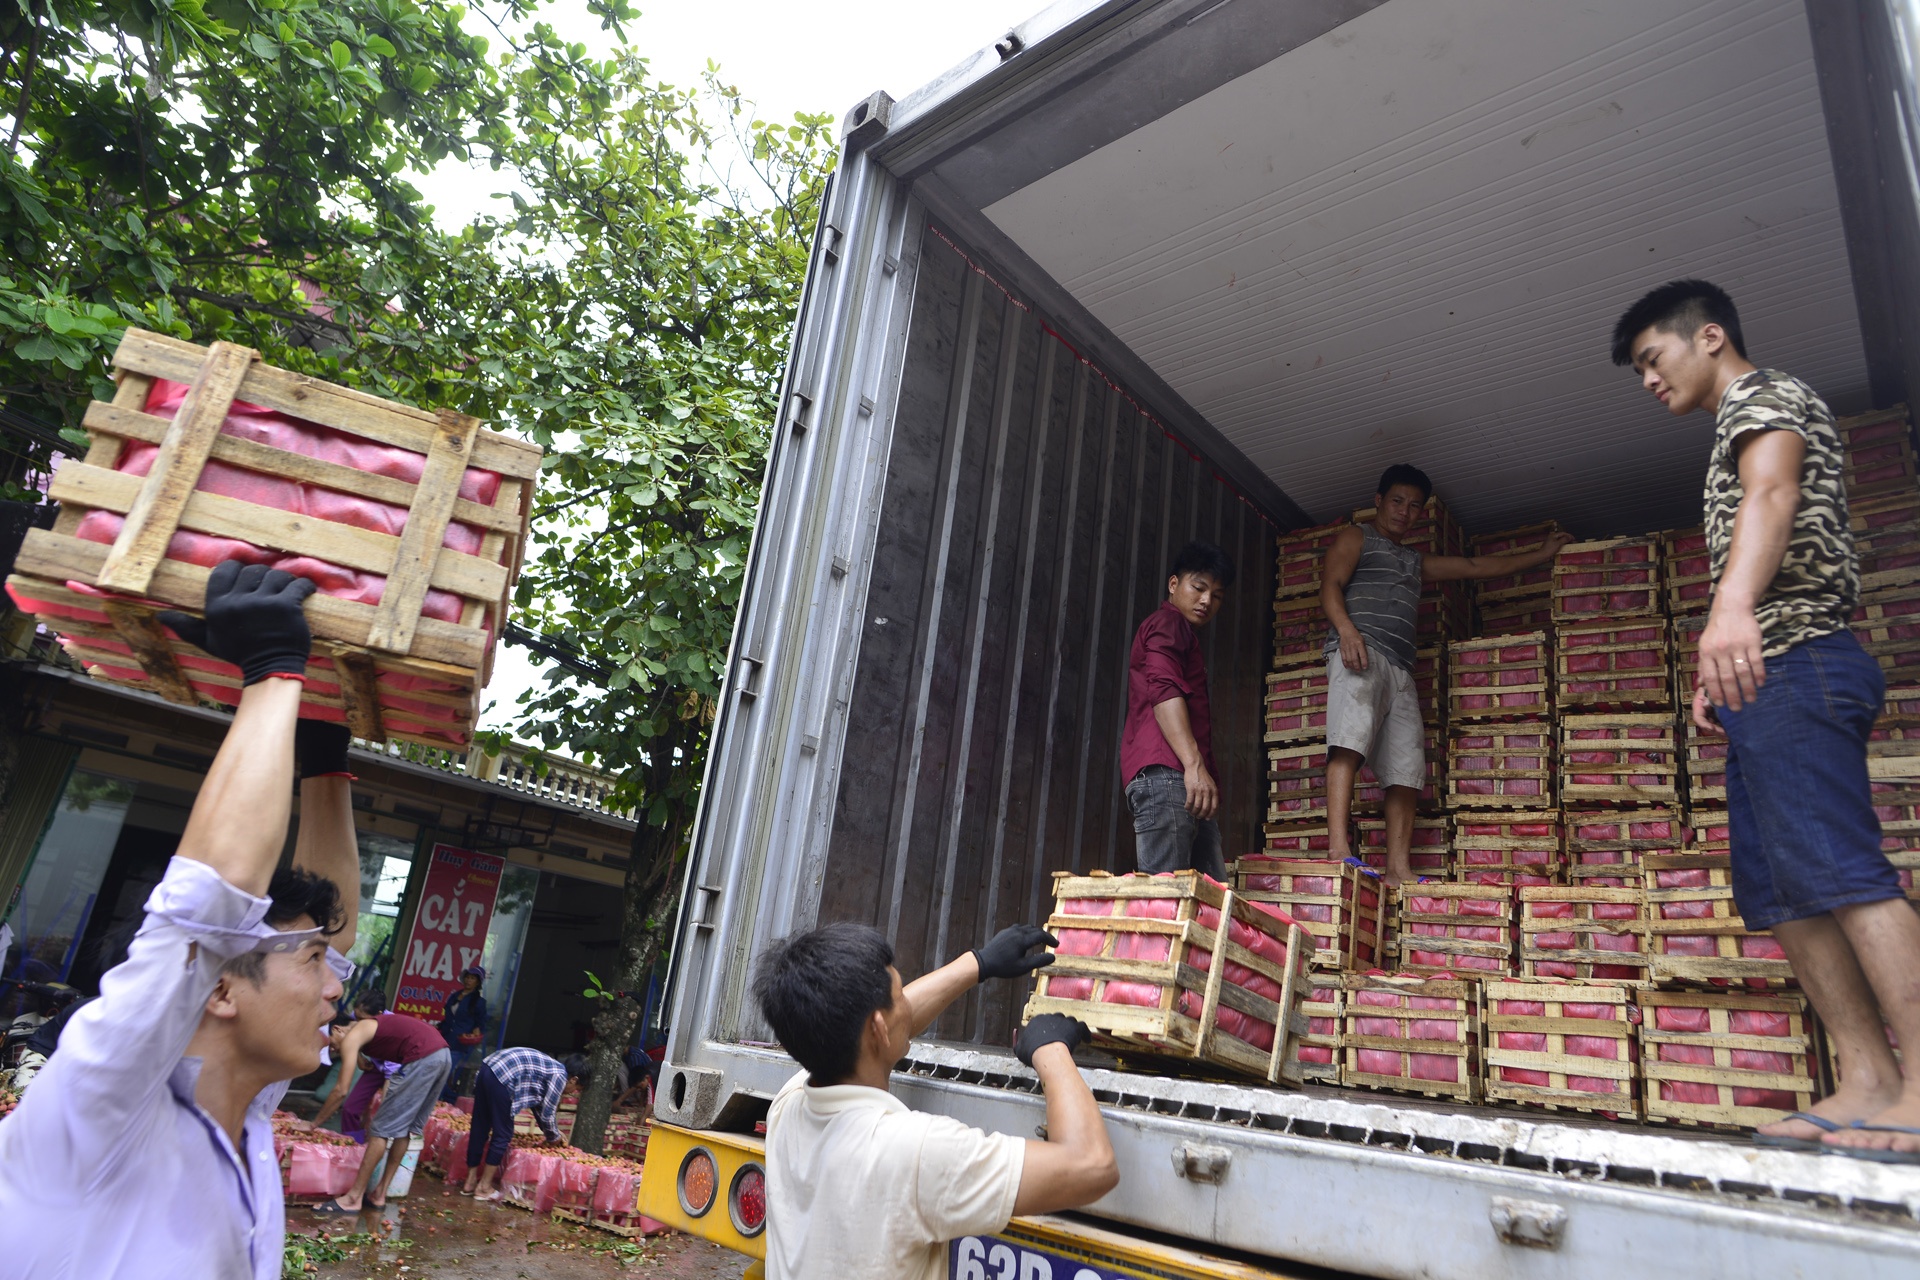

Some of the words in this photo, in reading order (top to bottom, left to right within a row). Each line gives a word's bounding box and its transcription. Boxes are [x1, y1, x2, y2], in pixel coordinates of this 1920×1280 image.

[931, 226, 939, 234] NO
[938, 232, 954, 248] CARGO
[954, 246, 968, 260] ABOVE
[974, 266, 986, 276] LINE
[421, 878, 485, 937] CẮT
[405, 939, 481, 982] MAY
[397, 1002, 431, 1015] NAM
